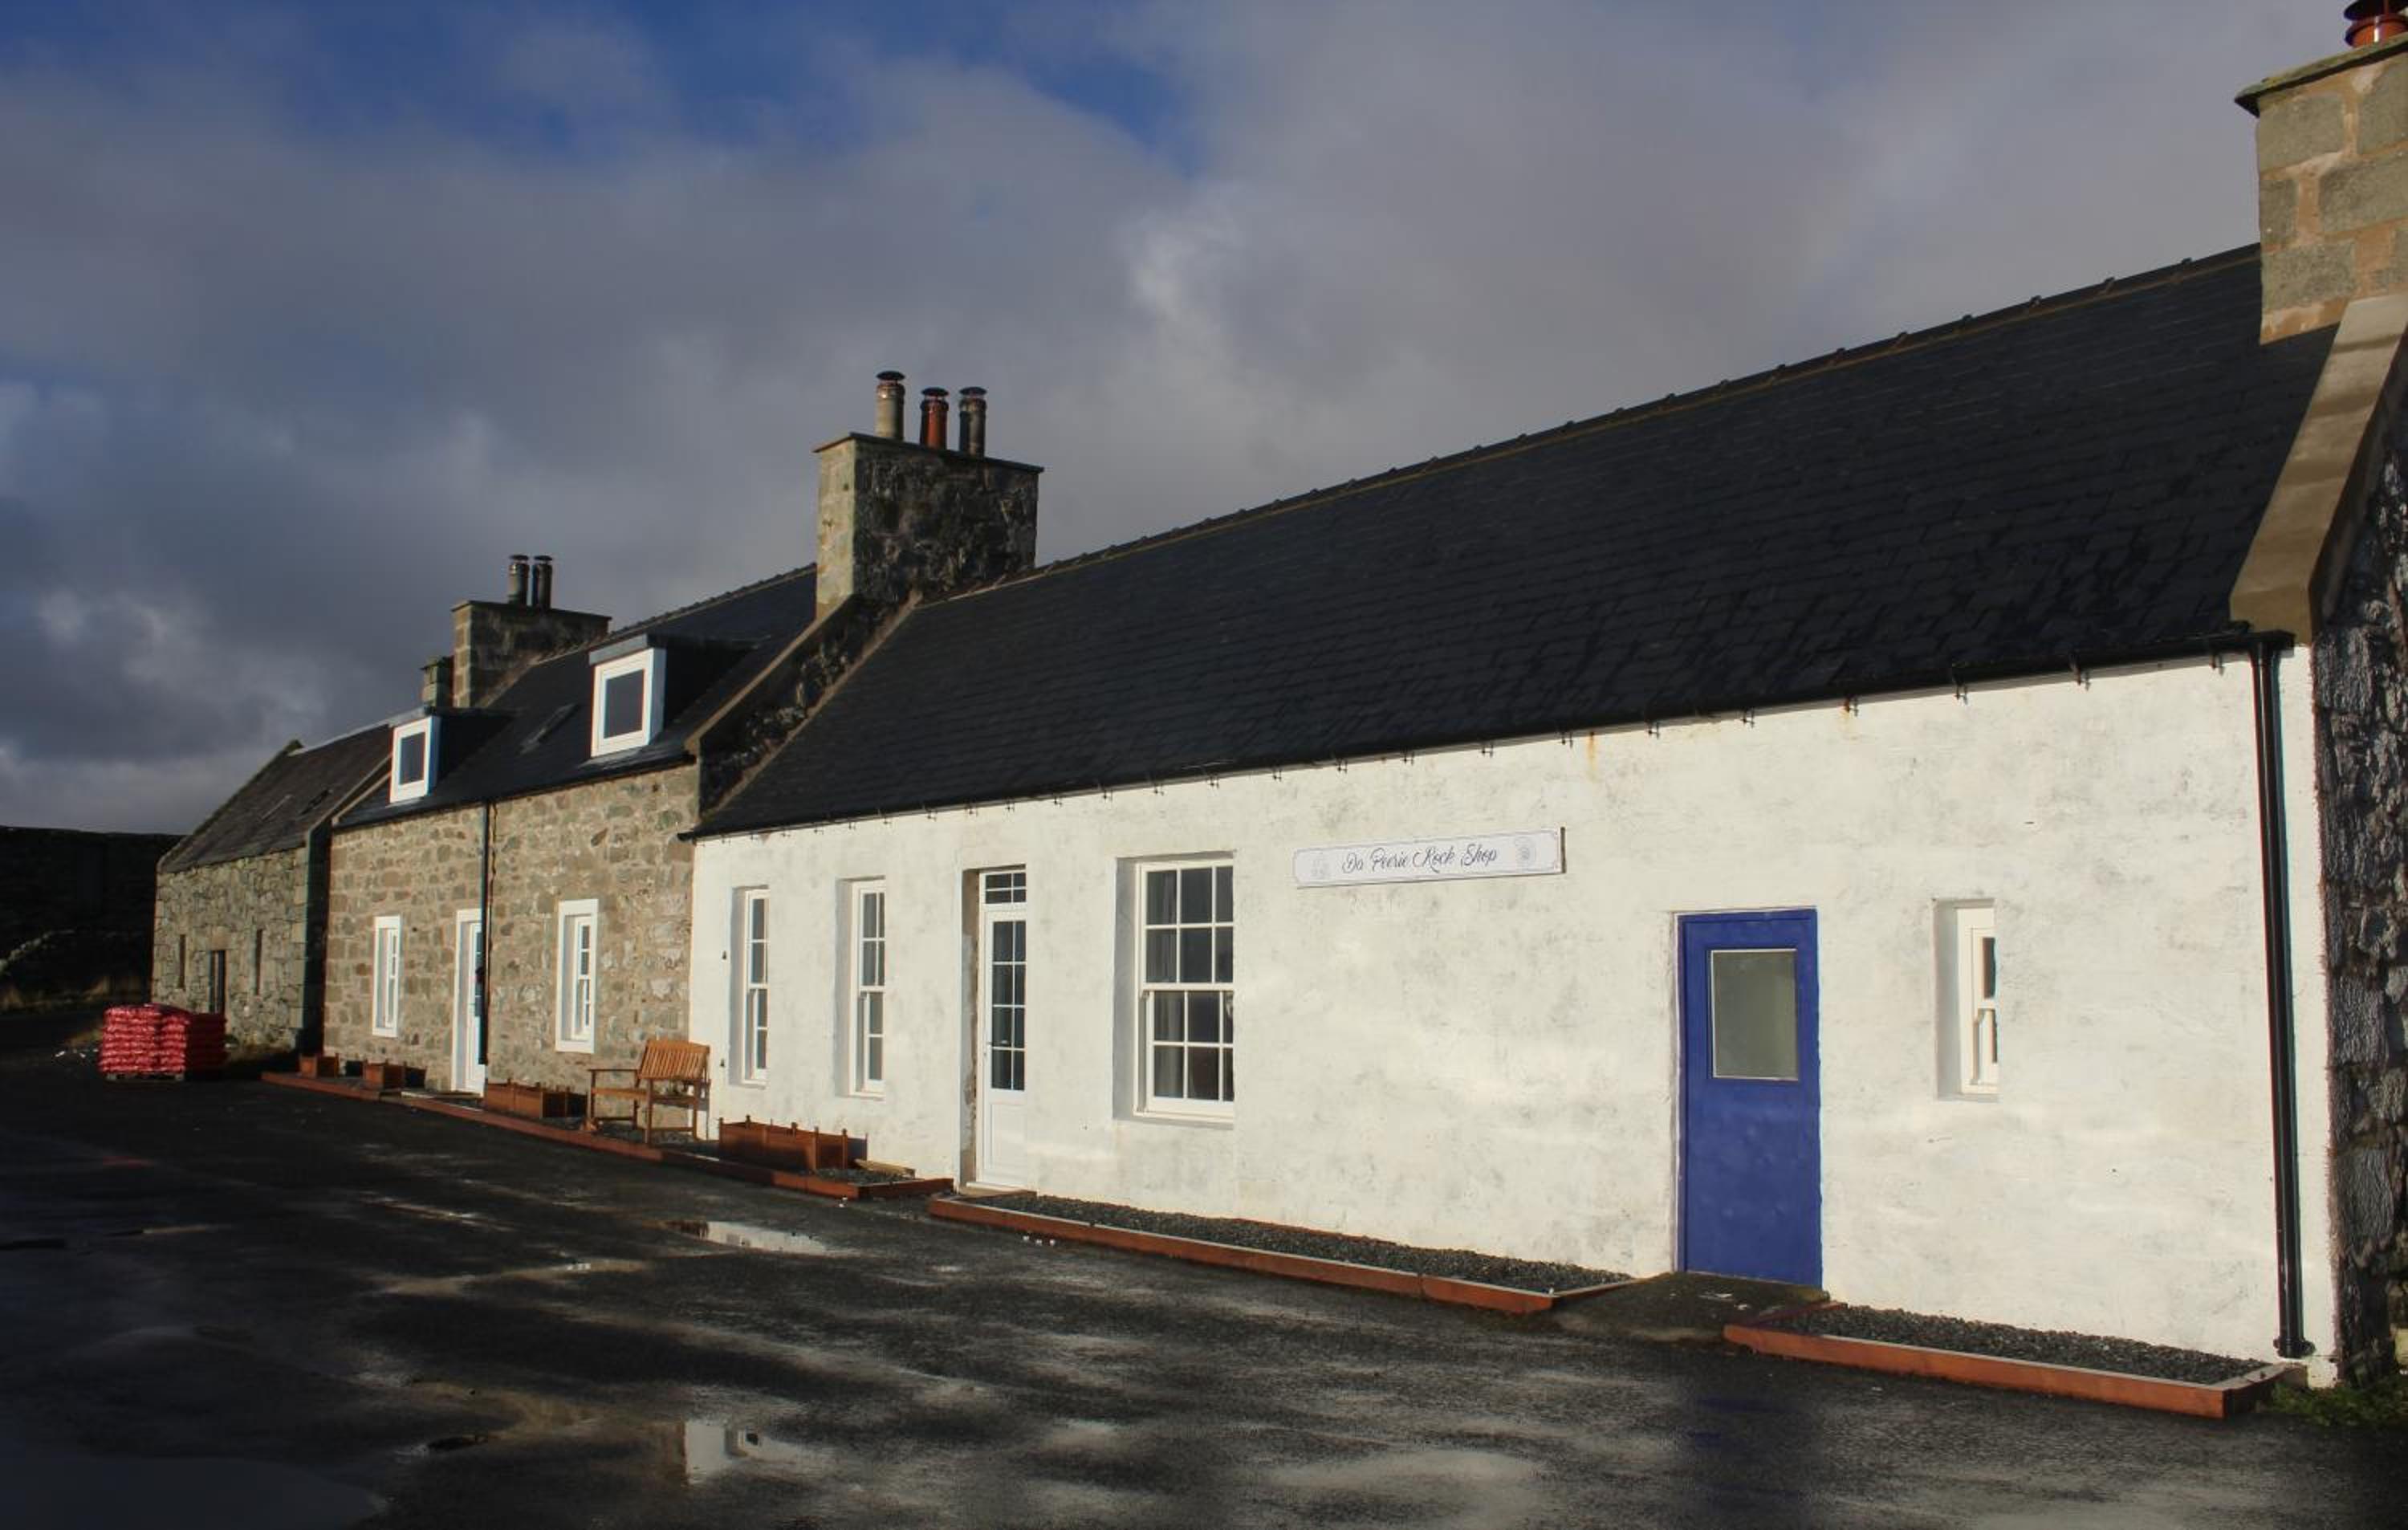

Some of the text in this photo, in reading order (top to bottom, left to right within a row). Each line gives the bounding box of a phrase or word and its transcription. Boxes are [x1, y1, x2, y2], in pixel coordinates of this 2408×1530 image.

[1342, 844, 1497, 873] Da Peerie Rock Shop
